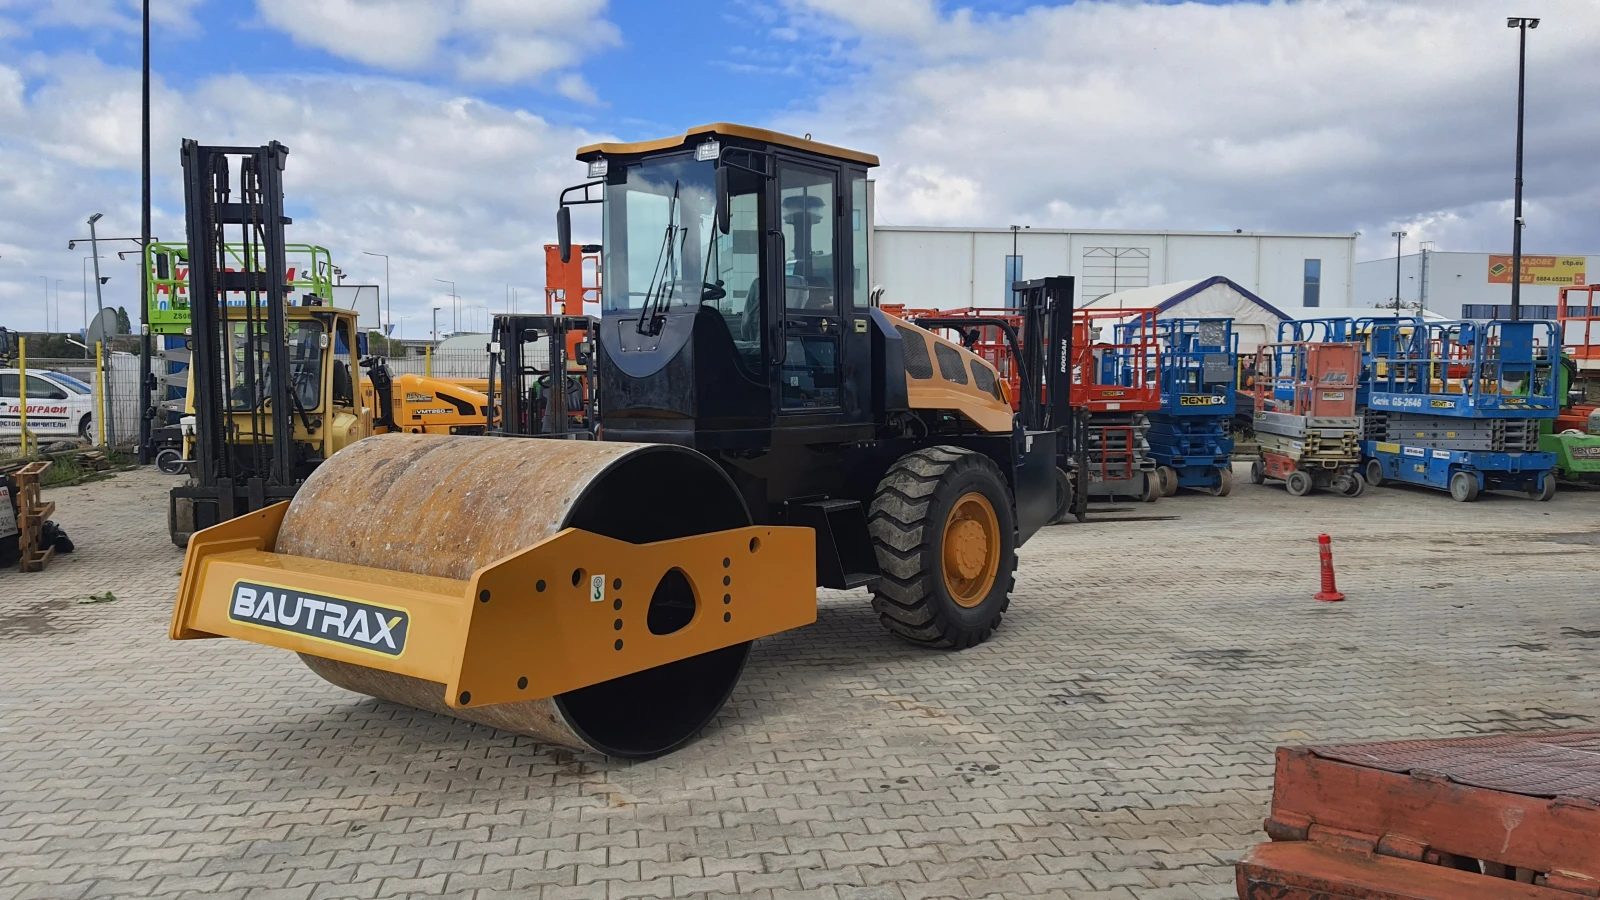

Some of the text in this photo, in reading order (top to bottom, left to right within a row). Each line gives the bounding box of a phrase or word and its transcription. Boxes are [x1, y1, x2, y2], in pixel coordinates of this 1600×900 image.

[1320, 371, 1349, 382] JLG
[1181, 396, 1226, 405] RENTEX
[1373, 395, 1422, 407] Genie GS-2646
[1431, 400, 1455, 408] RENTEX
[8, 405, 68, 414] ТАОГРАФИ
[233, 586, 403, 649] BAUTRAX
